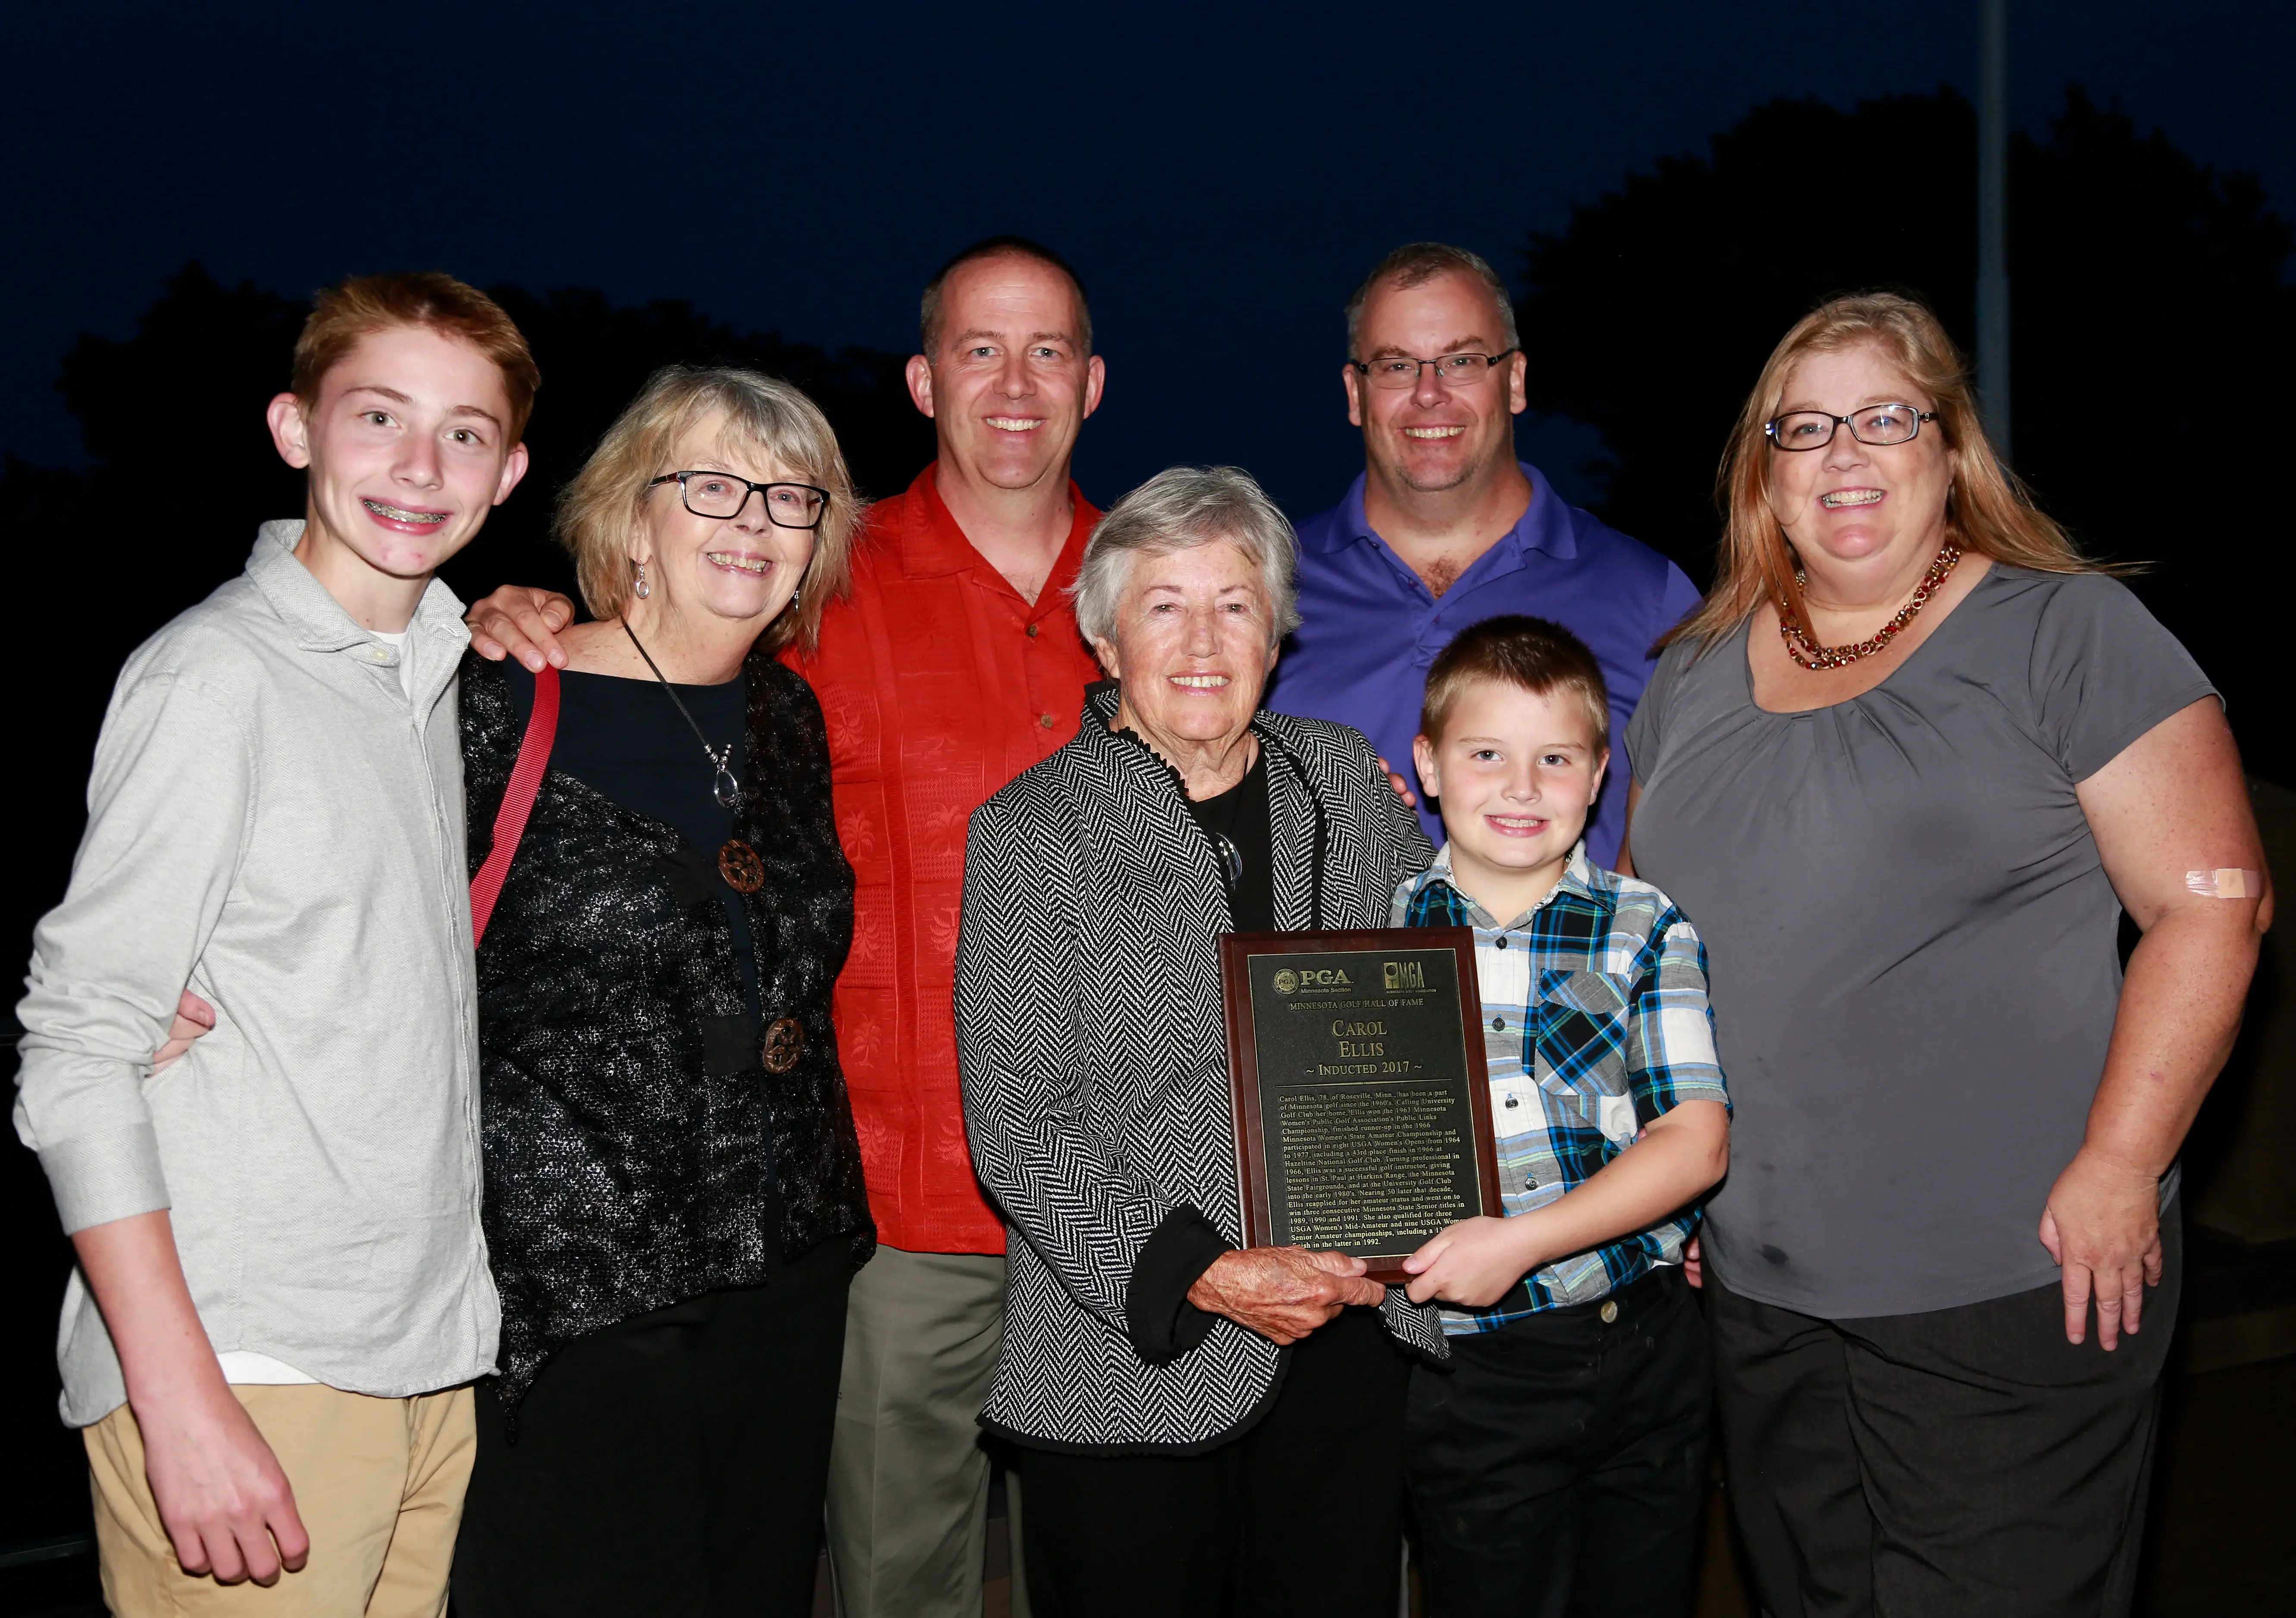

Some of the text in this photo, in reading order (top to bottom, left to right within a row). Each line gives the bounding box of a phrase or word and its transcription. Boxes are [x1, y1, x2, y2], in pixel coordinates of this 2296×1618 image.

[1300, 969, 1351, 985] PGA
[1399, 962, 1425, 988] MGA
[1290, 1002, 1338, 1010] MINNESOTA
[1381, 1061, 1409, 1072] 2017
[1341, 1092, 1372, 1101] Roseville,
[1396, 1098, 1419, 1107] Calling
[1422, 1096, 1455, 1105] University
[1282, 1126, 1330, 1136] Championship,
[1397, 1129, 1442, 1139] Championship
[1283, 1143, 1322, 1152] participated
[1405, 1138, 1425, 1147] Opens
[1314, 1150, 1344, 1159] including
[1369, 1148, 1386, 1156] place
[1386, 1155, 1410, 1163] Turning
[1413, 1153, 1451, 1162] professional
[1380, 1164, 1394, 1172] golf
[1395, 1163, 1428, 1171] instructor,
[1430, 1161, 1450, 1170] giving
[1385, 1171, 1407, 1180] Range,
[1306, 1182, 1346, 1192] Fairgrounds,
[1384, 1179, 1417, 1188] University
[1316, 1192, 1331, 1200] early
[1359, 1189, 1385, 1198] Nearing
[1306, 1199, 1336, 1208] reapplied
[1393, 1211, 1422, 1220] qualified
[1345, 1229, 1394, 1239] championships,
[1397, 1228, 1427, 1237] including
